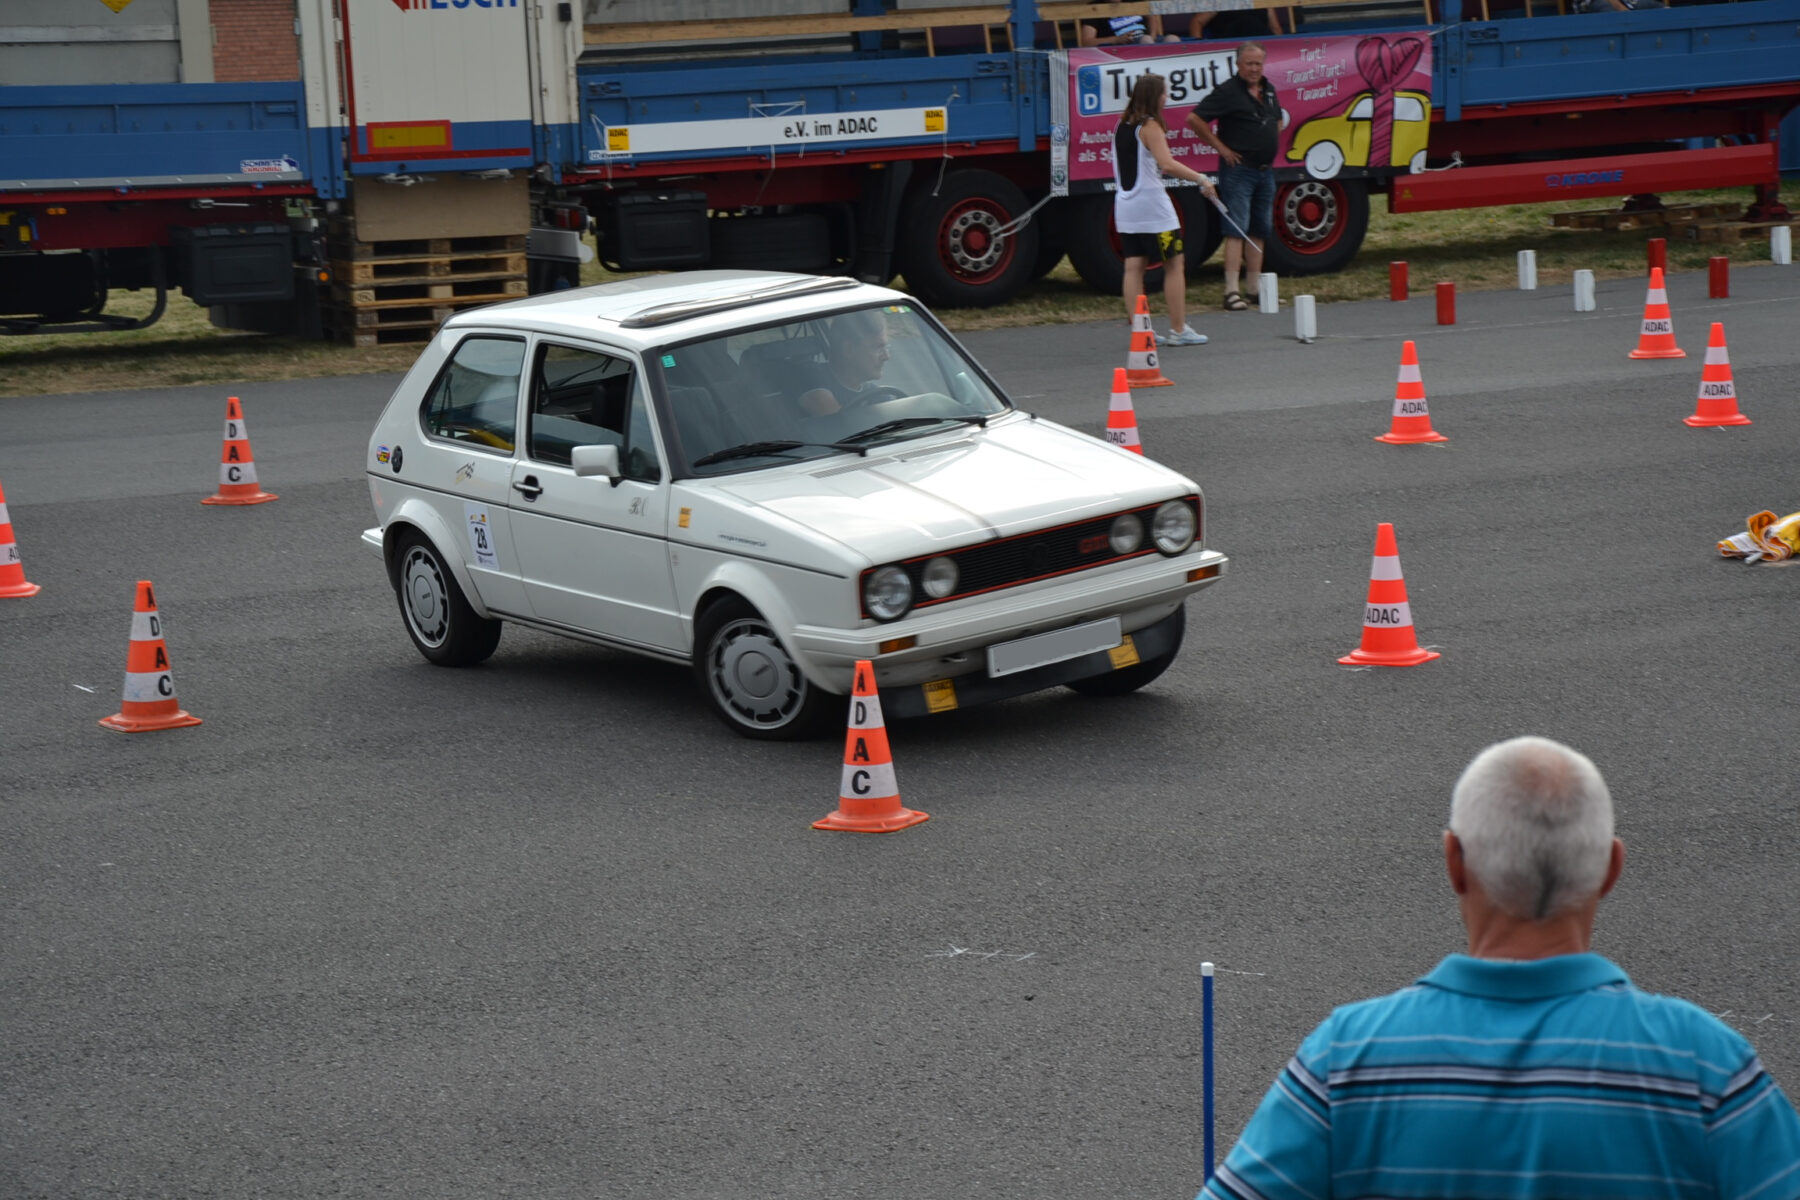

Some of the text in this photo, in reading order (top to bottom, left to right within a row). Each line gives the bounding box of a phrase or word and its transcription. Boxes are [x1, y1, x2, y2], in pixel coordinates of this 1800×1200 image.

[1106, 67, 1150, 100] Tu
[1169, 60, 1219, 101] gut
[1083, 93, 1098, 110] D
[784, 117, 878, 138] e.V. im ADAC
[1192, 143, 1219, 156] Vera
[1561, 169, 1625, 186] KRONE
[1645, 321, 1669, 332] ADAC
[1703, 383, 1732, 396] ADAC
[228, 403, 241, 482] ADAC
[1106, 431, 1126, 444] DAC
[1366, 607, 1400, 625] ADAC
[146, 586, 173, 697] ADAC
[851, 671, 872, 795] ADAC
